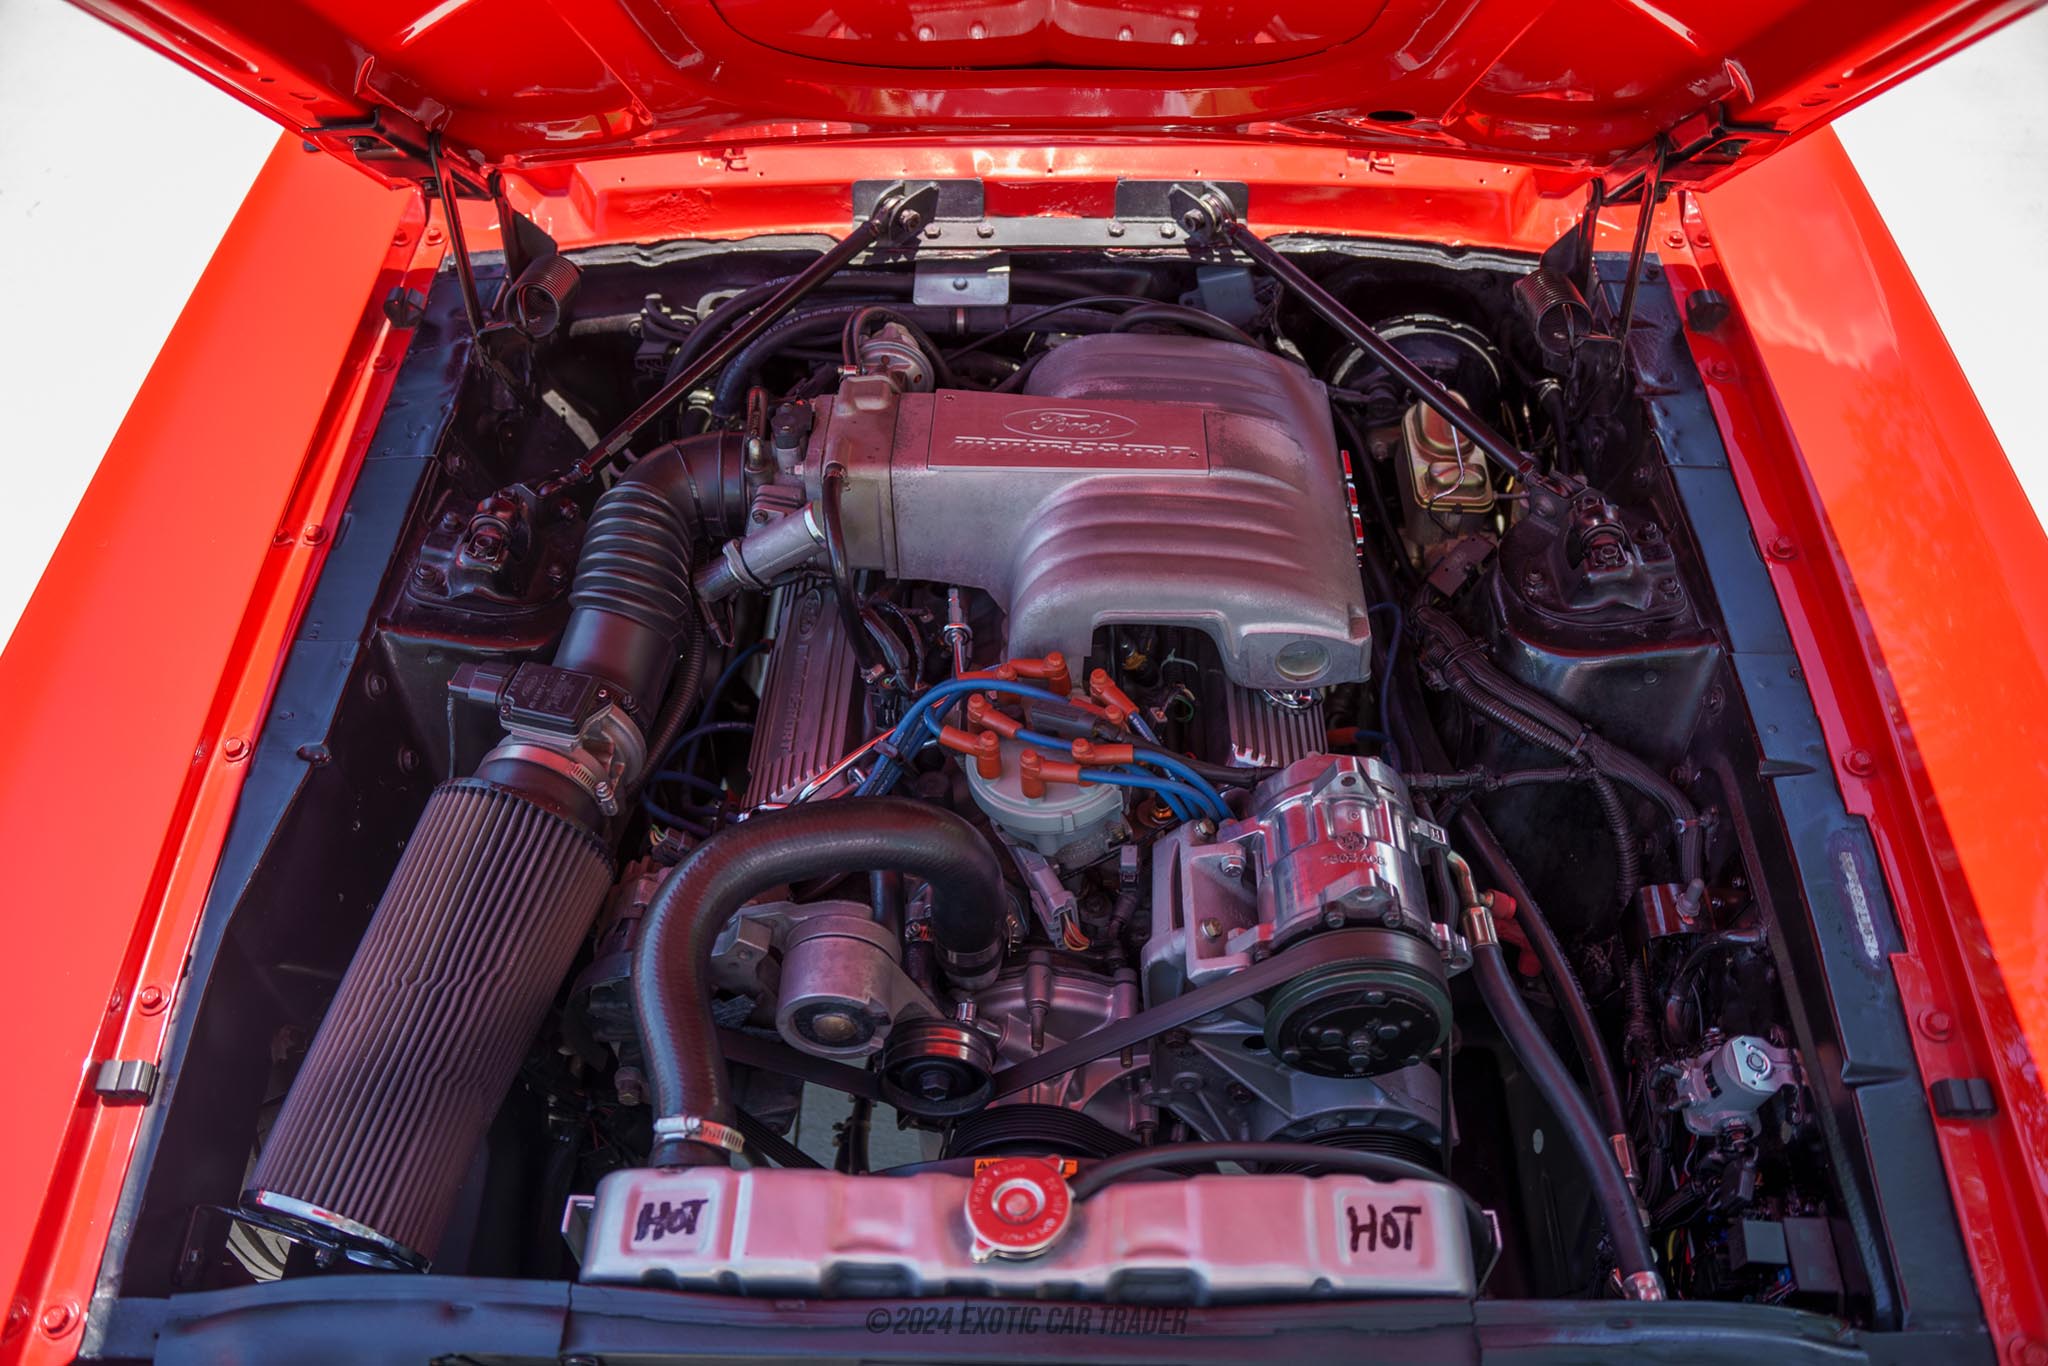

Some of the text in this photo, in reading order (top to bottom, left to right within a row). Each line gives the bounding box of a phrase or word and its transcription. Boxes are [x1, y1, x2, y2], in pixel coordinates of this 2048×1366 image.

[1030, 412, 1110, 434] Ford
[634, 1199, 709, 1241] HOT
[1346, 1204, 1422, 1252] HOT
